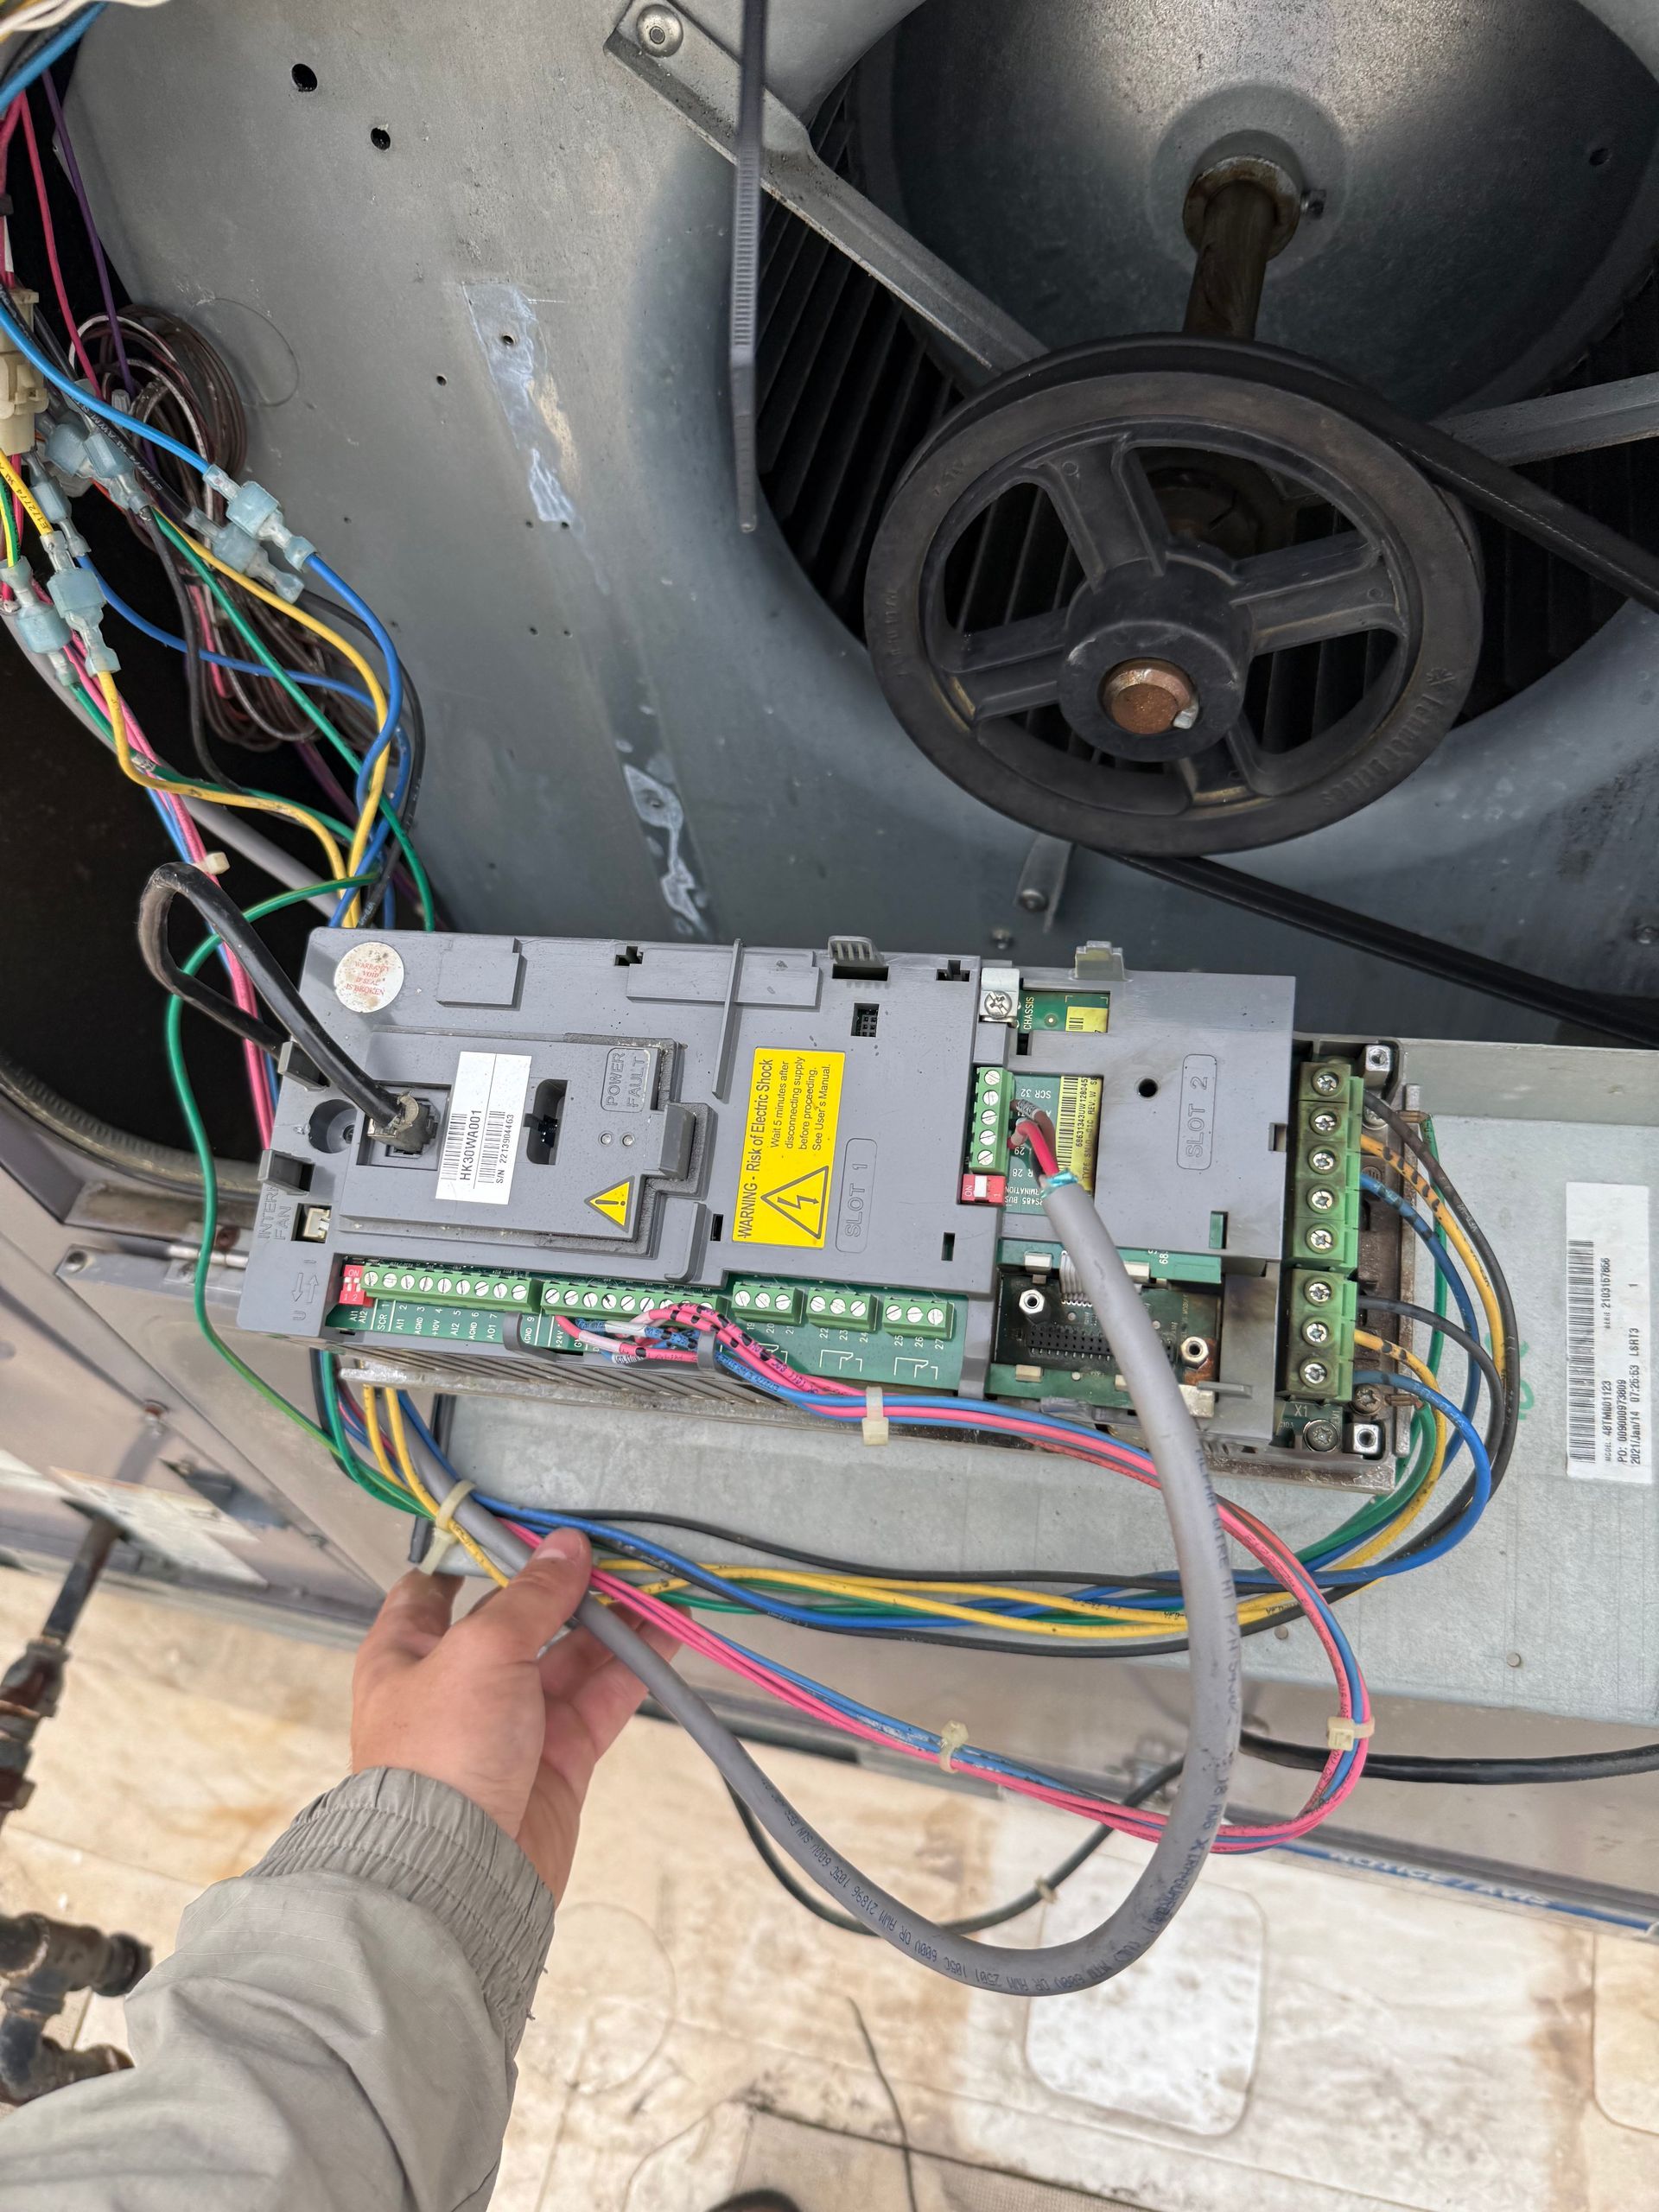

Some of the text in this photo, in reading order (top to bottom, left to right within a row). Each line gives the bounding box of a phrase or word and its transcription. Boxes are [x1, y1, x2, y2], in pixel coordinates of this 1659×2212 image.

[16, 489, 49, 529] E172774
[353, 985, 386, 995] BROKEN
[1023, 996, 1034, 1030] CHASSIS
[607, 1052, 626, 1106] POWER
[756, 1058, 773, 1092] Shock
[779, 1060, 790, 1081] after
[627, 1056, 645, 1108] FAULT
[776, 1083, 786, 1118] minutes
[785, 1056, 805, 1149] disconnecting supply
[1020, 1089, 1052, 1099] SCR 32
[751, 1095, 769, 1134] Electric
[798, 1067, 818, 1150] before proceeding.
[812, 1064, 831, 1151] See User's Manual.
[1185, 1076, 1209, 1158] SLOT 2
[460, 1110, 482, 1180] HK30WA001
[753, 1135, 764, 1147] of
[770, 1126, 782, 1148] Wait
[496, 1114, 514, 1184] S/N 2213904463
[1014, 1147, 1025, 1155] 29
[746, 1147, 762, 1172] Risk
[1013, 1169, 1023, 1178] 28
[964, 1185, 972, 1197] ON
[1005, 1196, 1019, 1205] BUS
[738, 1182, 758, 1239] WARNING
[845, 1183, 866, 1237] SLOT
[275, 1205, 291, 1240] FAN
[347, 1268, 359, 1277] ON
[352, 1294, 358, 1302] 2
[349, 1310, 359, 1321] AI1
[358, 1311, 368, 1324] AI2
[377, 1313, 388, 1332] SCR
[397, 1319, 405, 1330] AI1
[415, 1317, 423, 1335] AGND
[432, 1319, 441, 1336] +10V
[450, 1322, 461, 1336] AI2
[468, 1321, 478, 1340] AGND
[487, 1324, 496, 1339] AO1
[747, 1322, 755, 1331] 19
[766, 1323, 775, 1333] 20
[785, 1325, 794, 1334] 21
[819, 1328, 829, 1339] 22
[839, 1330, 848, 1340] 23
[860, 1332, 868, 1343] 24
[894, 1335, 903, 1346] 25
[914, 1337, 924, 1347] 26
[935, 1338, 944, 1350] 27
[1294, 1404, 1307, 1417] X1
[1630, 1410, 1641, 1465] 2021/Jan/14
[1618, 1446, 1628, 1465] PO:
[830, 1866, 850, 1889] 105C
[851, 1885, 879, 1916] 21896
[878, 1912, 898, 1932] AWM
[898, 1925, 912, 1946] OR
[914, 1939, 938, 1962] 600V
[944, 1956, 968, 1980] 105C
